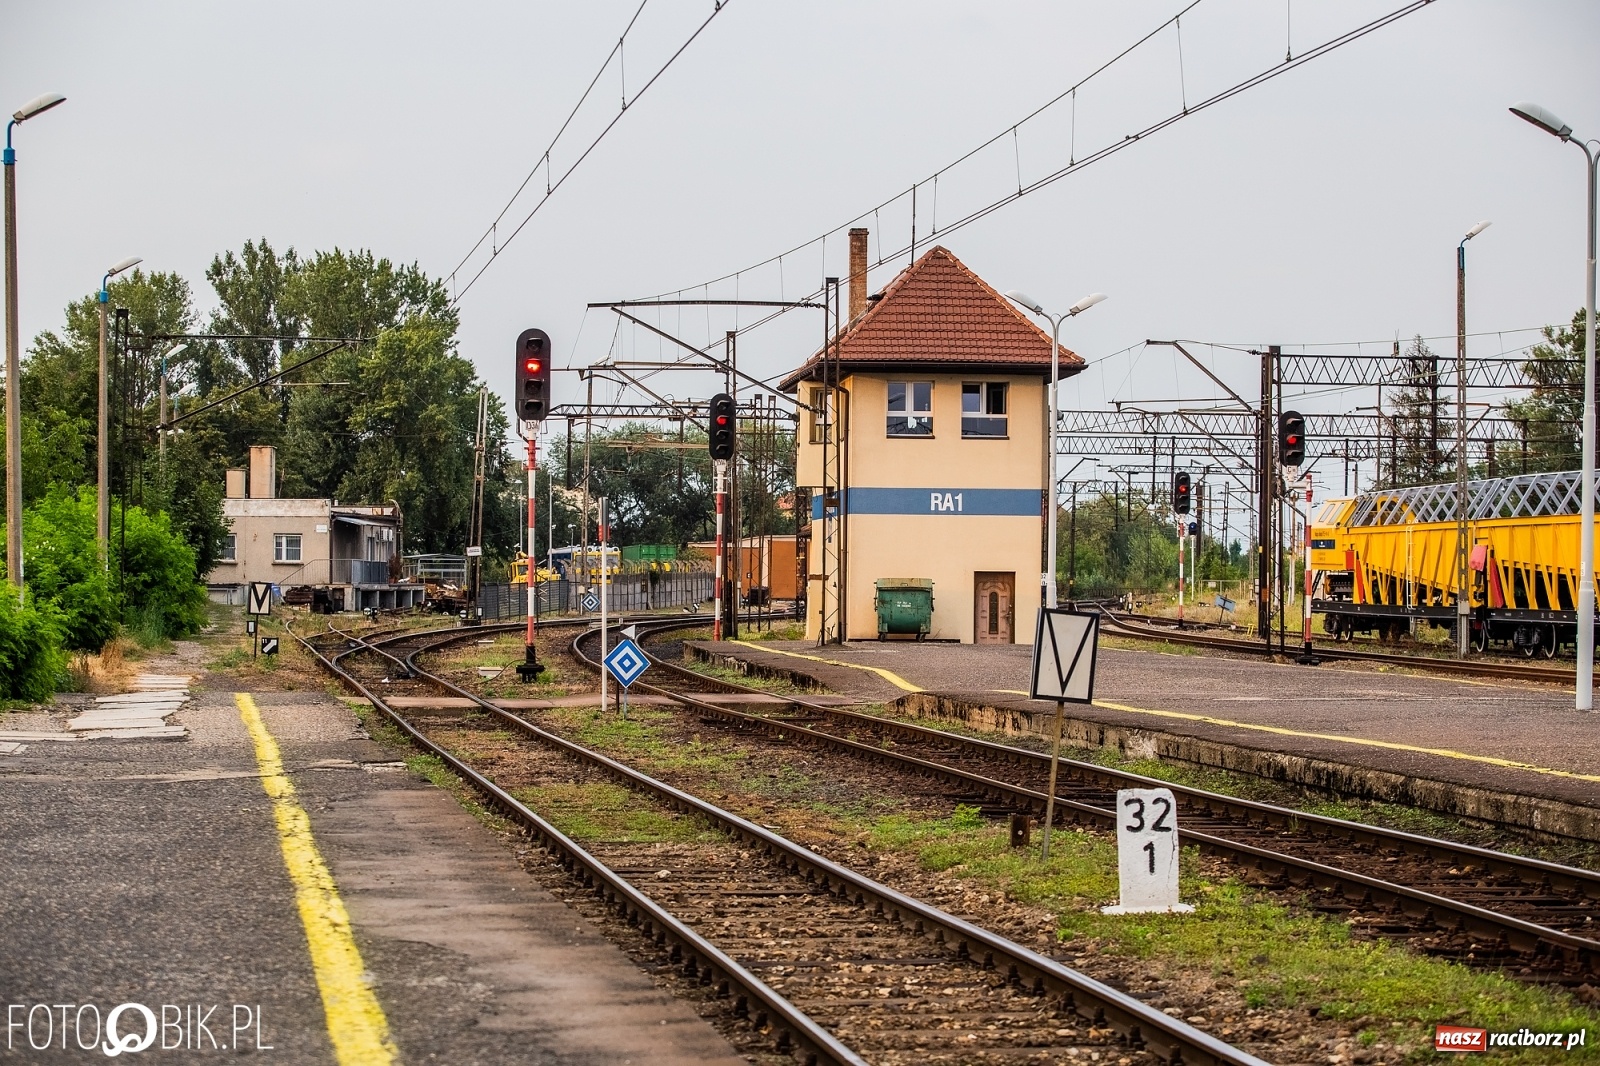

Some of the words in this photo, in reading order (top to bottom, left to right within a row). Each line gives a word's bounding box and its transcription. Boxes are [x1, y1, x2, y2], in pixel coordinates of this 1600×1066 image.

[930, 492, 963, 511] RA1
[1124, 797, 1172, 833] 32
[1143, 841, 1155, 873] 1
